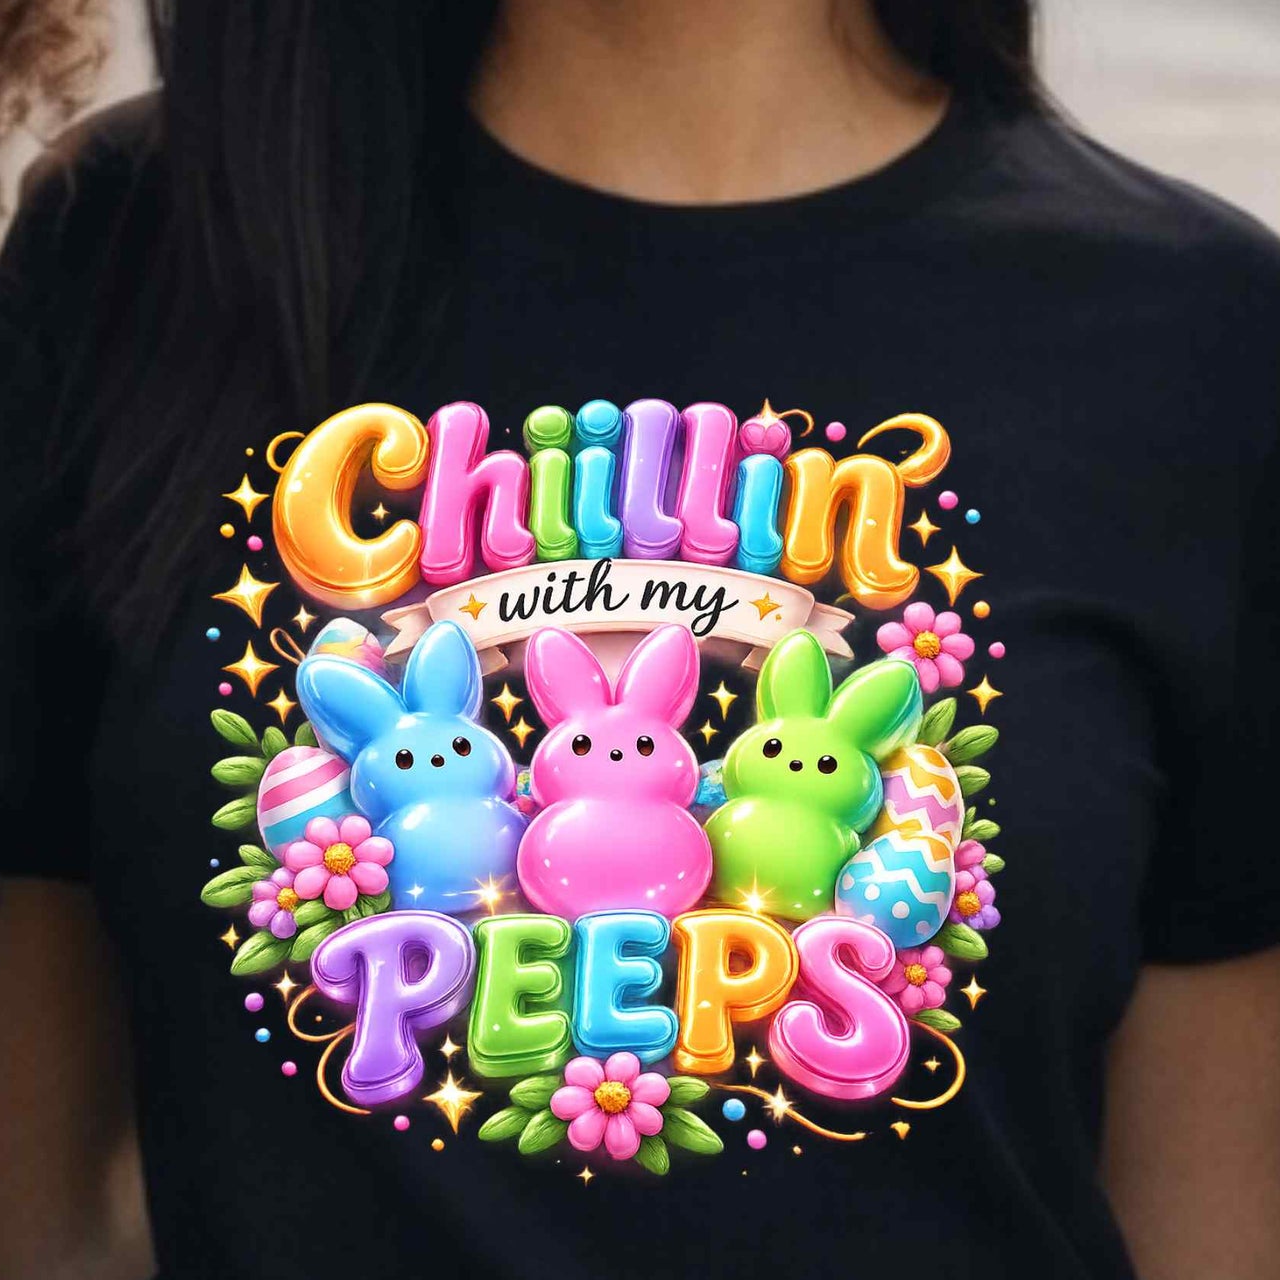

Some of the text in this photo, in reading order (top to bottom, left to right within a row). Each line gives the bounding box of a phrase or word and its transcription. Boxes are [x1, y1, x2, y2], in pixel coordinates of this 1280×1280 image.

[499, 557, 740, 637] with my
[311, 908, 911, 1104] PEEPS
